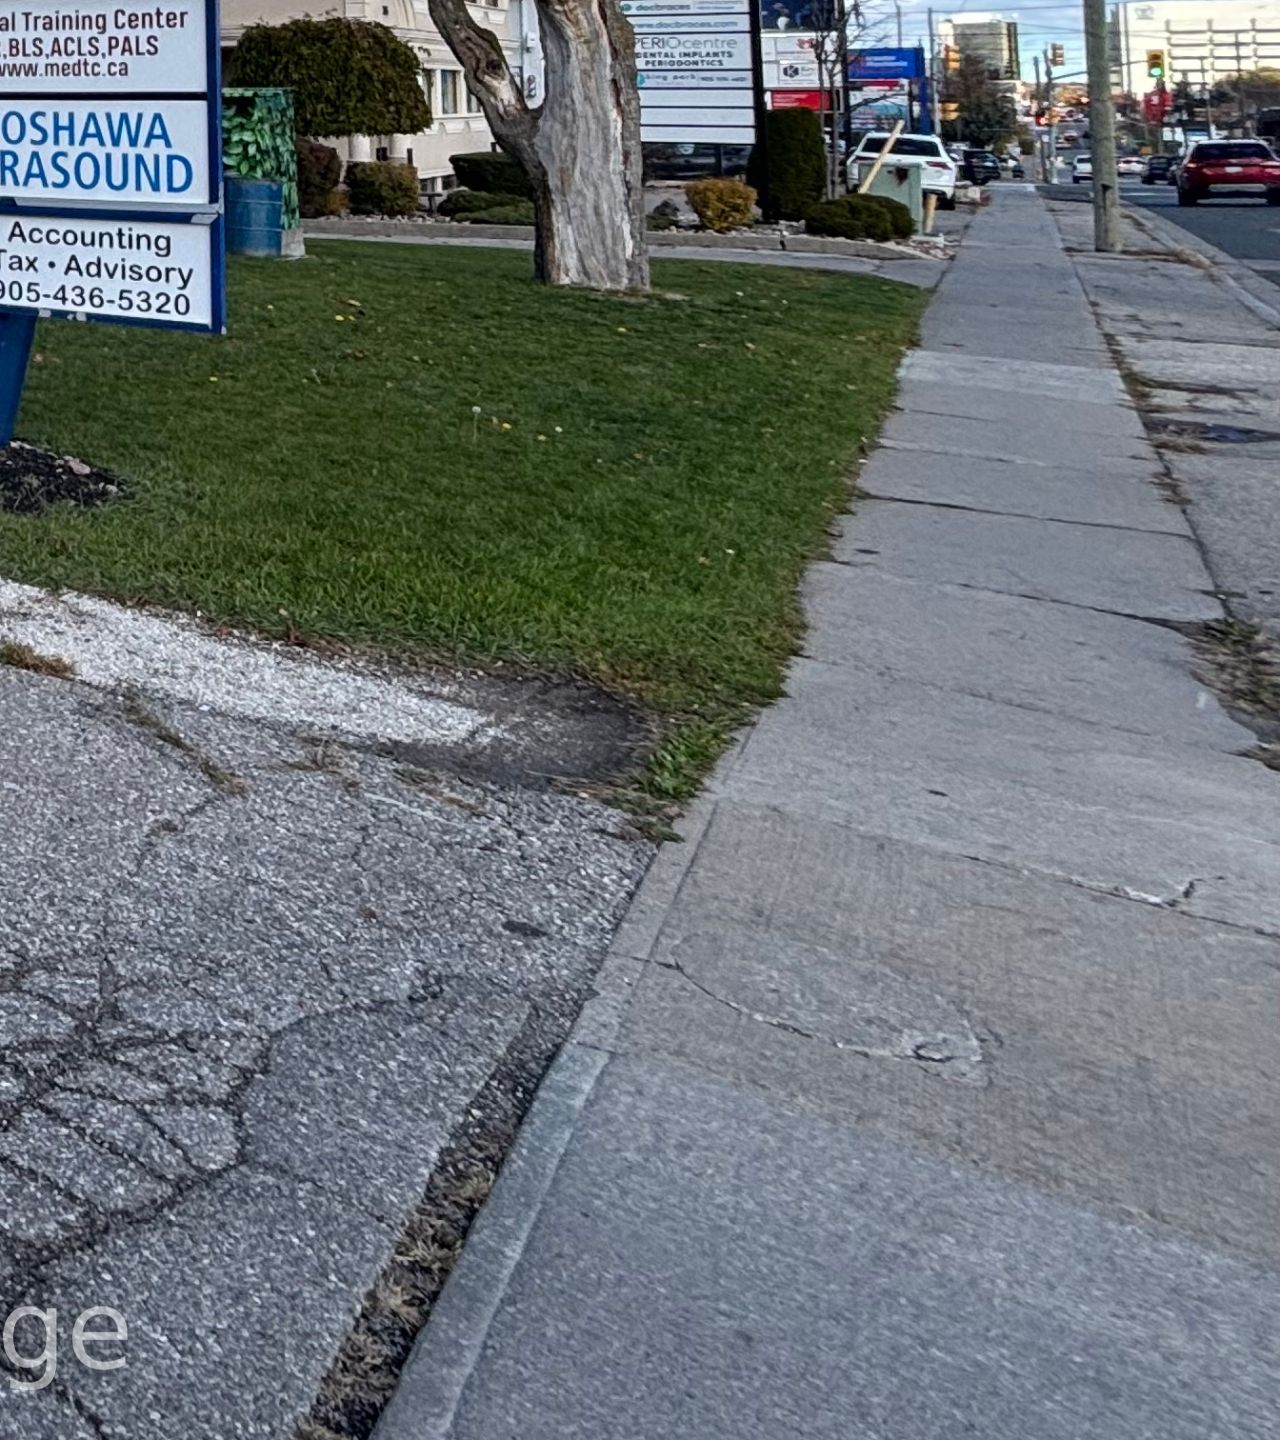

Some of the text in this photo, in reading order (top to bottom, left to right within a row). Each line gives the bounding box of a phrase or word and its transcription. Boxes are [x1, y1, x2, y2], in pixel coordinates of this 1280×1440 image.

[21, 10, 107, 35] Training
[113, 7, 188, 30] Center
[644, 59, 724, 67] PERIODONTICS
[1, 111, 172, 148] OSHAWA
[8, 221, 171, 258] Accounting
[64, 254, 193, 290] Advisory
